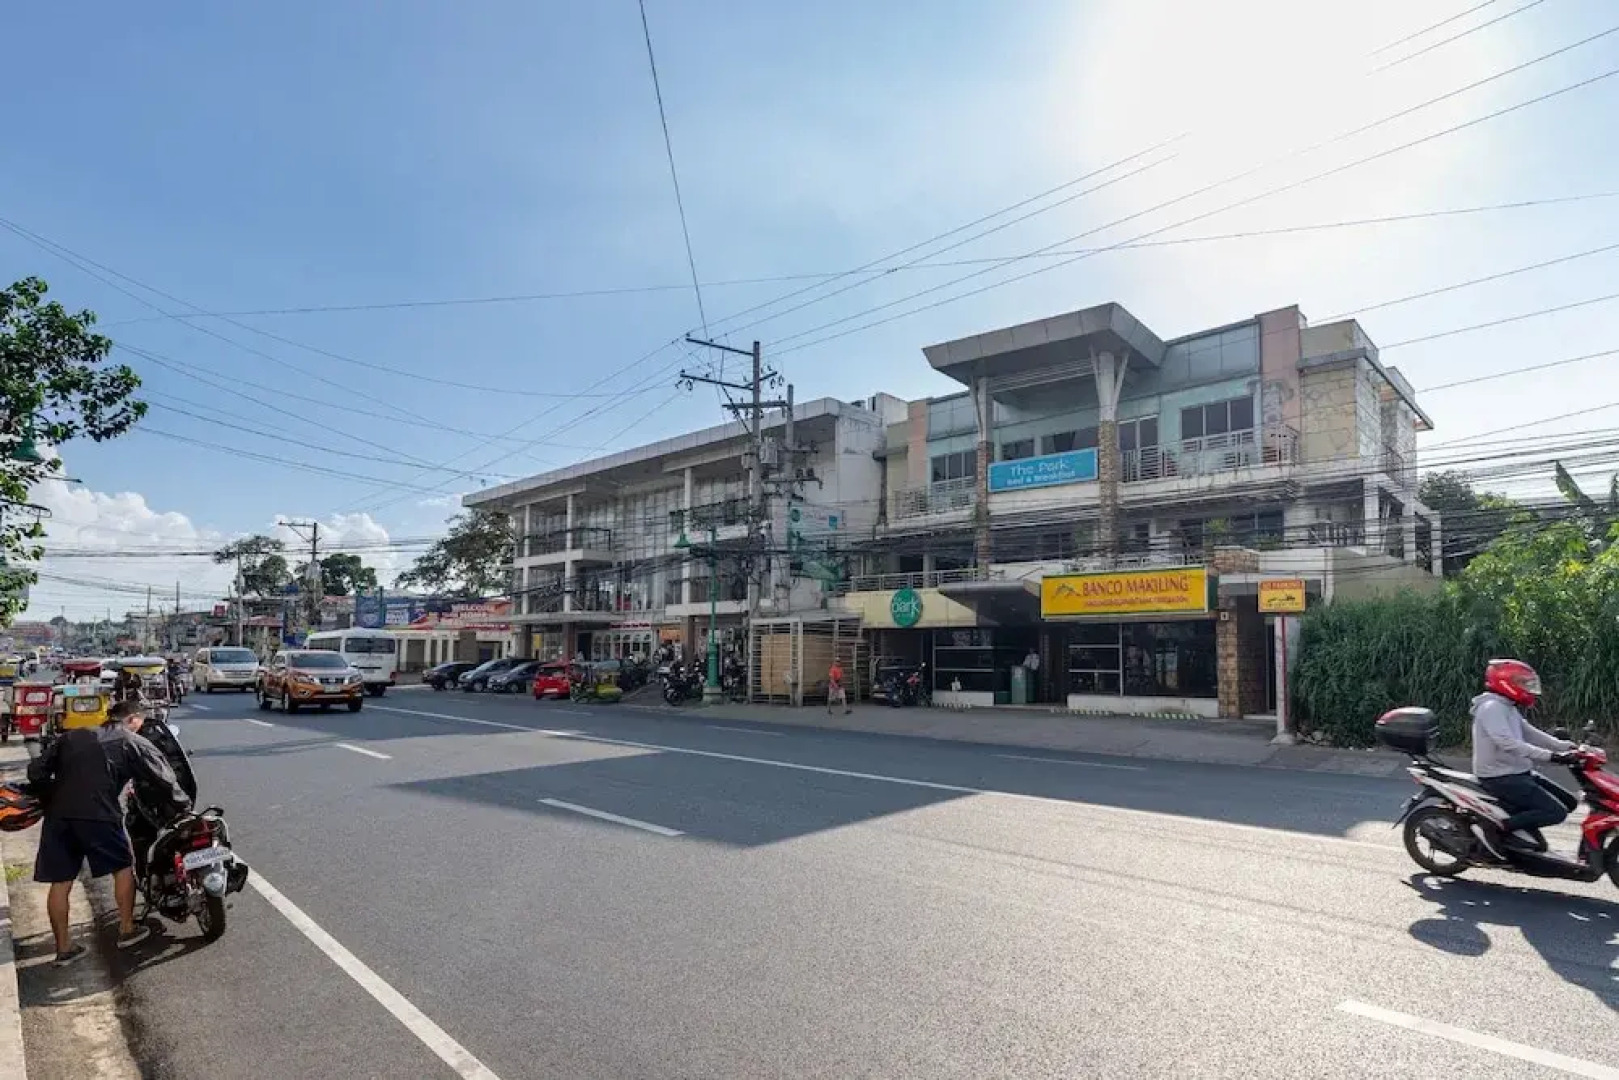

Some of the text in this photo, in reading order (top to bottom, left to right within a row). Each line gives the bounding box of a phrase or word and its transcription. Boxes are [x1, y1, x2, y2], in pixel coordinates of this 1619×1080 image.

[1010, 458, 1068, 477] The Park
[1082, 580, 1123, 597] BANCO
